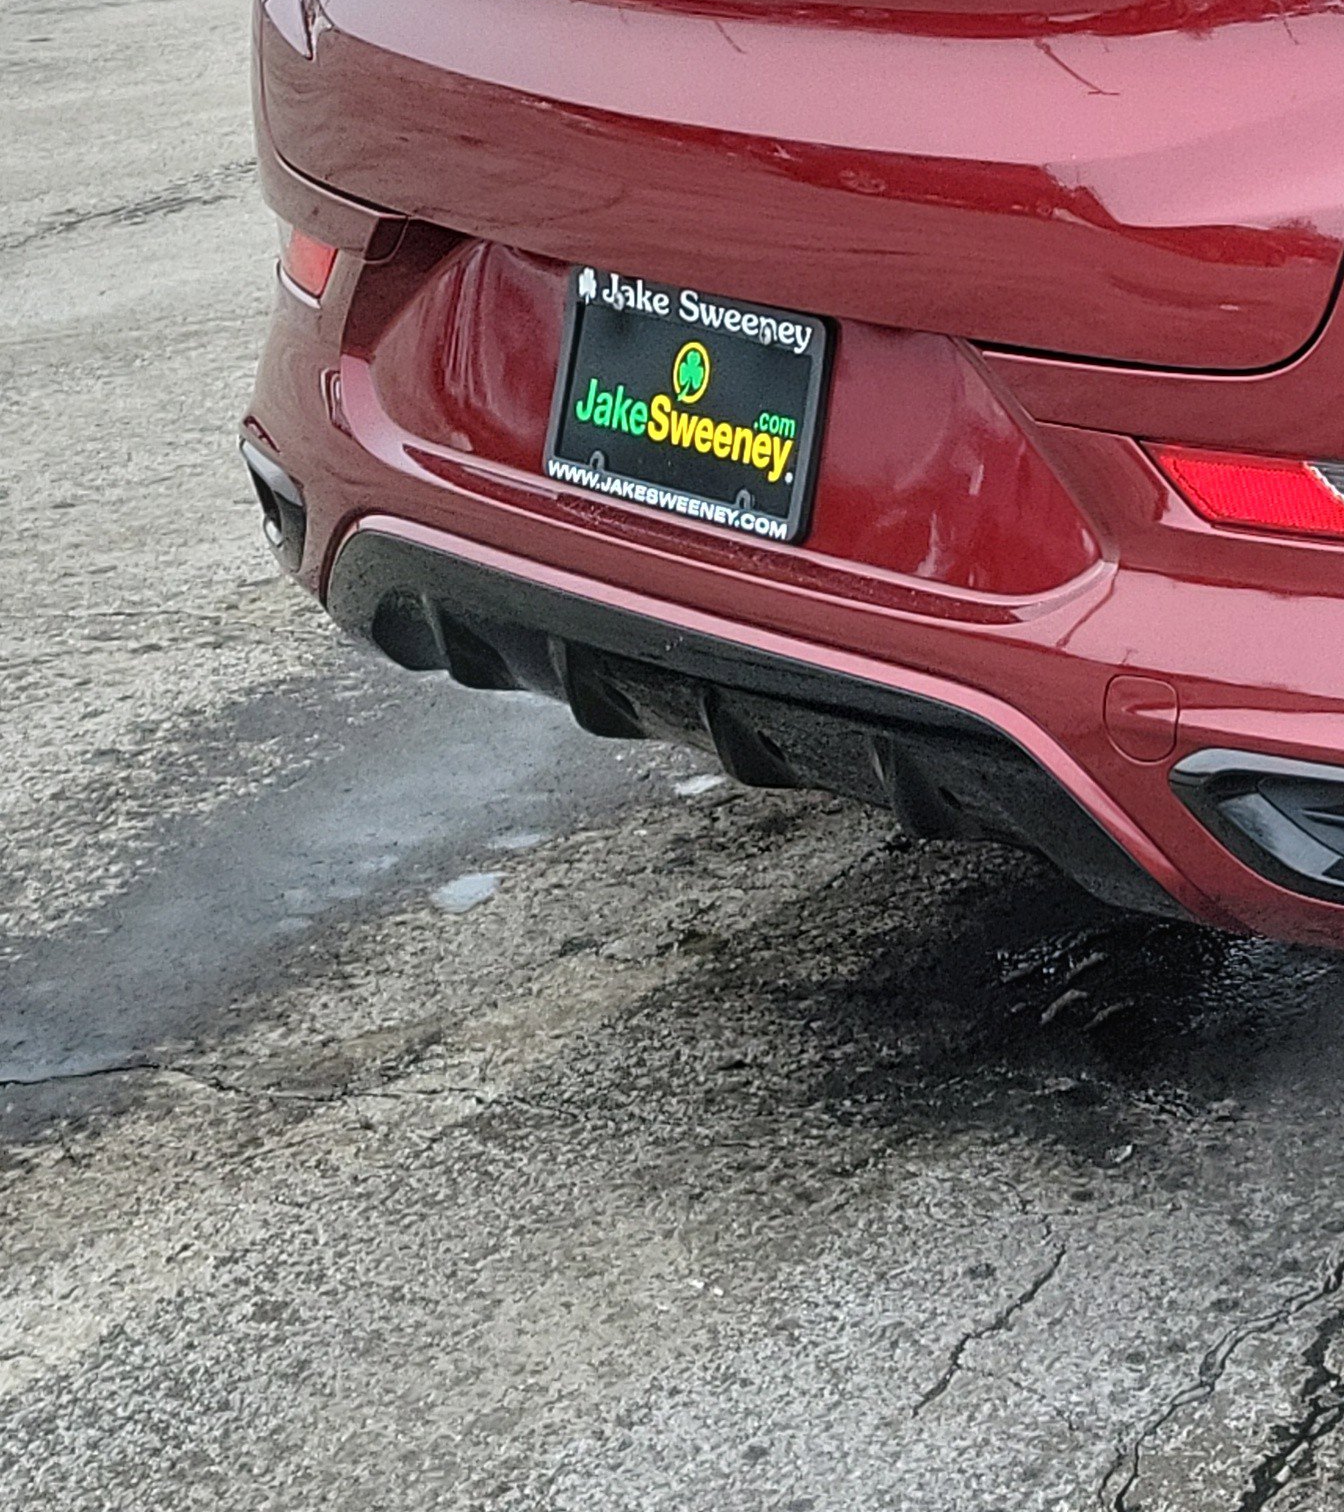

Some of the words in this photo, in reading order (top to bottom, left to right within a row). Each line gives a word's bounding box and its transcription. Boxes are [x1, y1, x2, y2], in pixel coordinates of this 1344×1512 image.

[602, 273, 670, 315] Jake
[679, 290, 812, 354] Sweeney
[548, 460, 788, 540] WWW.JAKESWEENEY.COM
